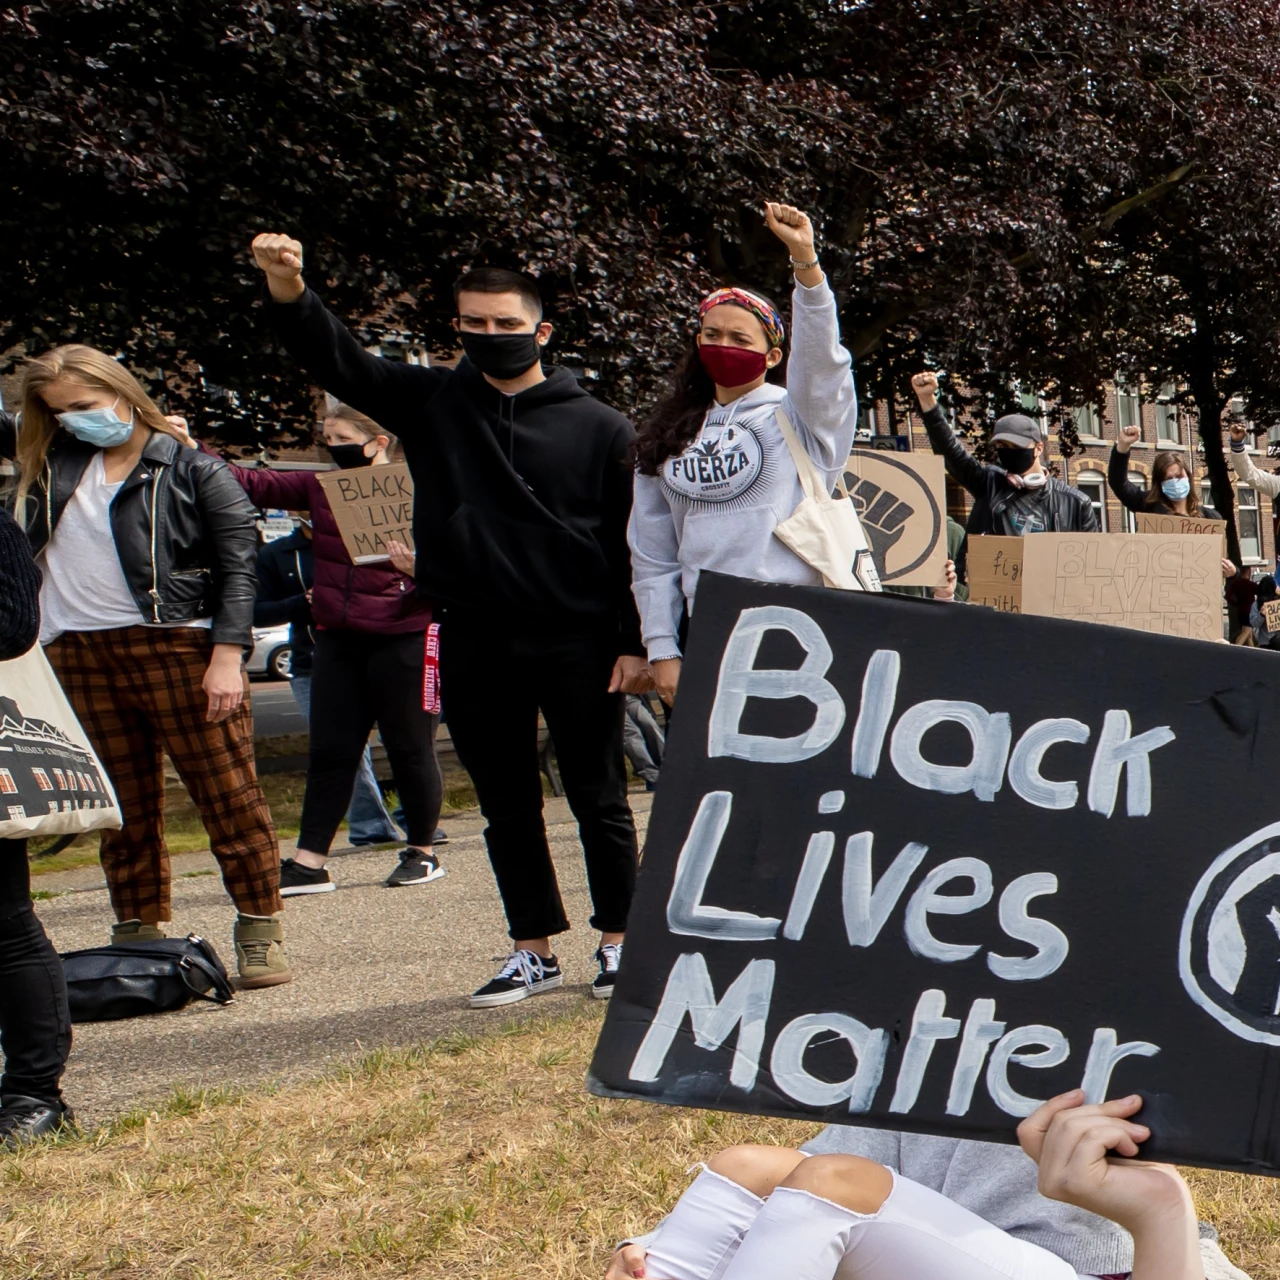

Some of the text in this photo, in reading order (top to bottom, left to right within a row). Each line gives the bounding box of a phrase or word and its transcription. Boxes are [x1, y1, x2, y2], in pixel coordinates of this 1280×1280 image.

[672, 451, 750, 483] FUERZA
[337, 475, 412, 501] BLACK
[368, 503, 412, 526] LIVE
[1144, 517, 1220, 534] NO PEACE
[353, 528, 412, 554] MATT
[994, 551, 1022, 580] fig
[1057, 540, 1211, 578] BLACK
[1053, 577, 1210, 614] LIVES
[1267, 603, 1280, 615] BLA
[427, 637, 437, 657] CREW
[707, 606, 1175, 818] Black
[667, 790, 1069, 980] Lives
[628, 952, 1161, 1117] Matter
